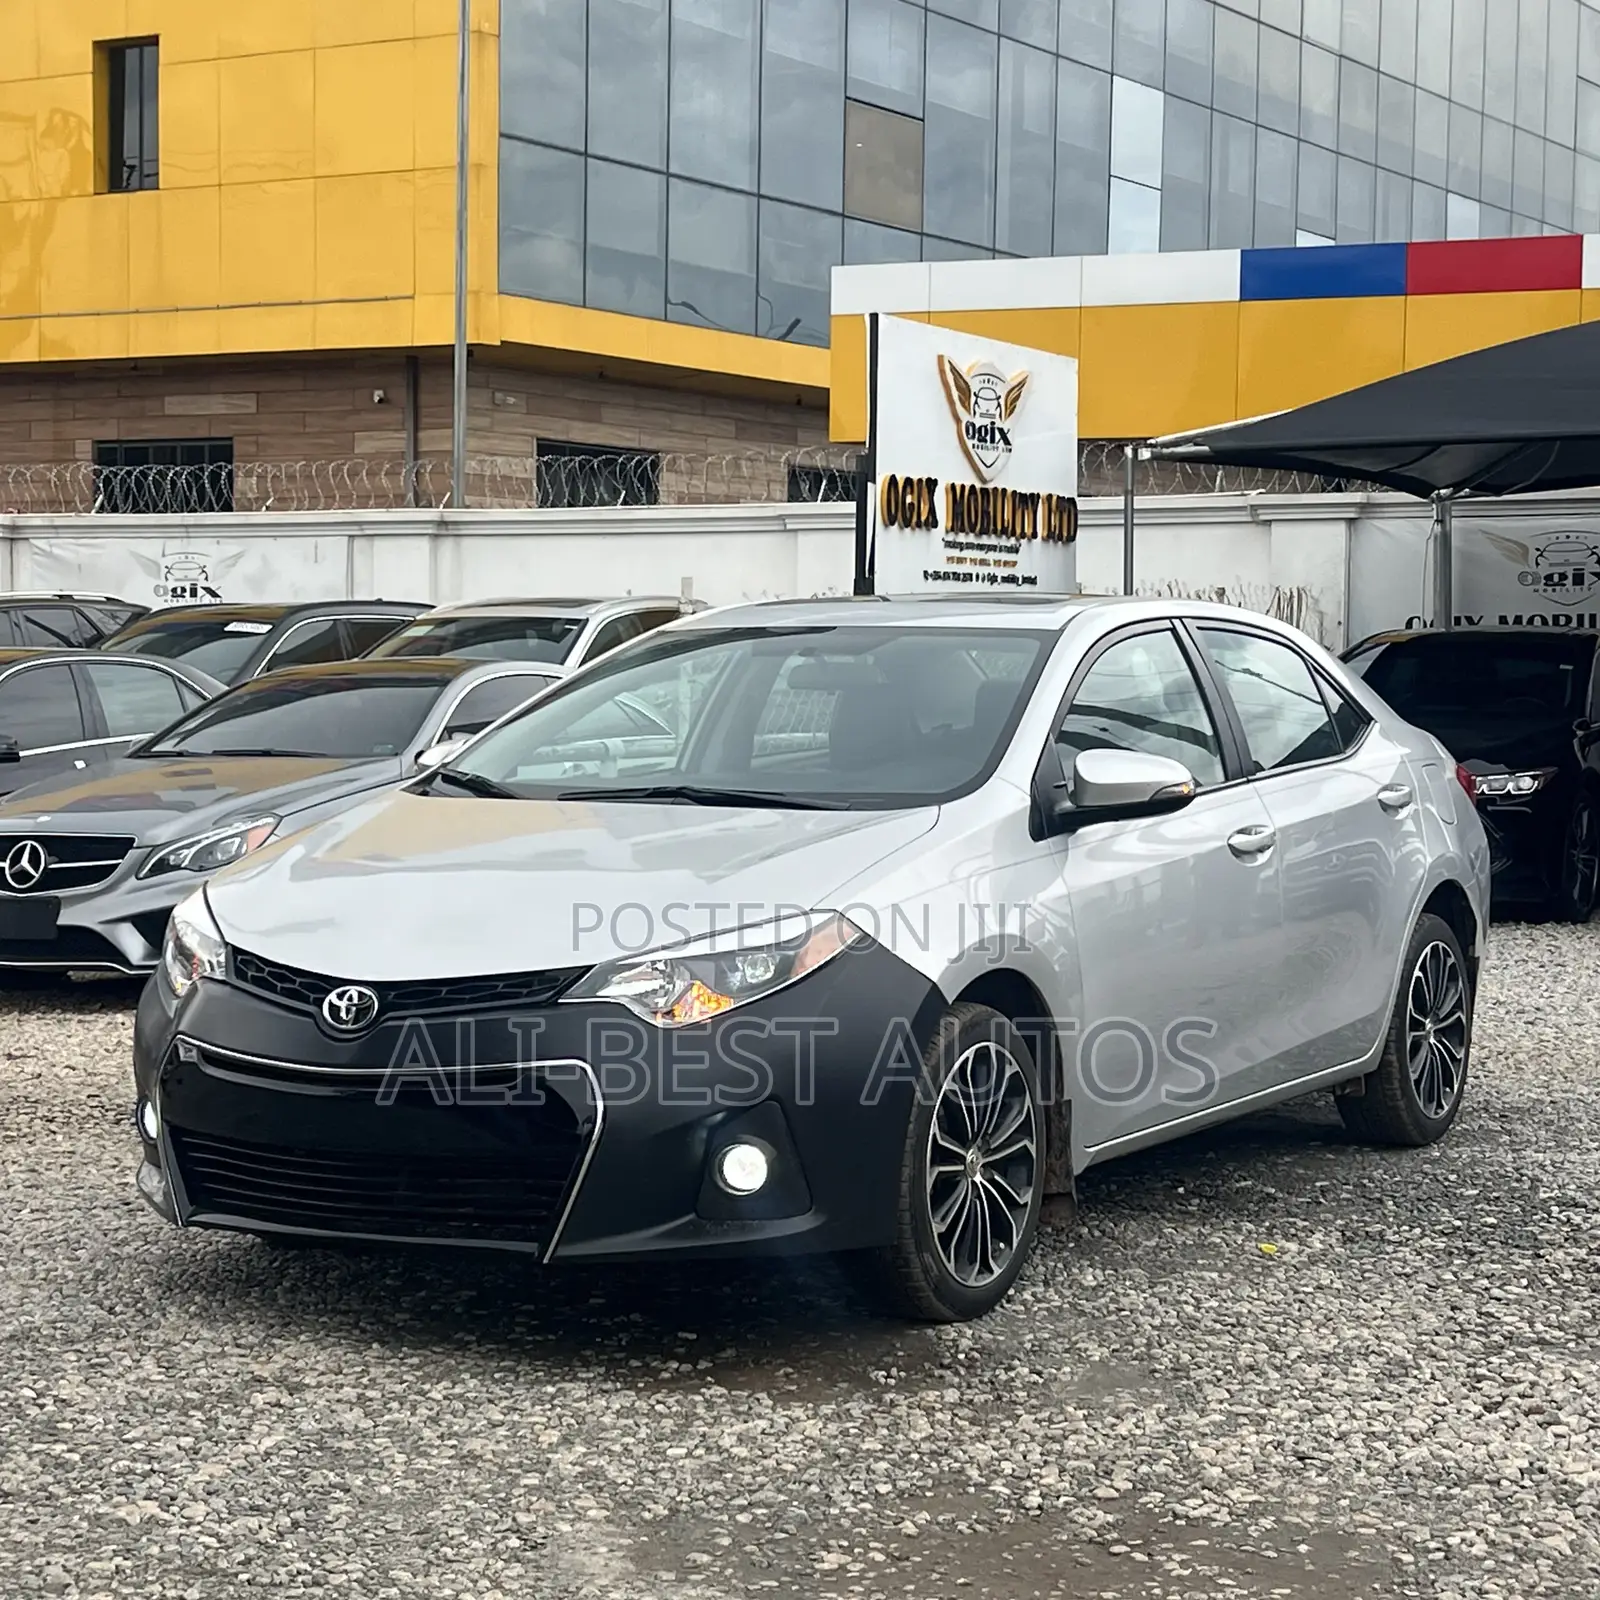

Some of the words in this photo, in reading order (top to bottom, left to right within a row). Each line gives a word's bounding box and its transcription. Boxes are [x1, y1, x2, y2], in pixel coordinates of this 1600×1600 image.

[881, 474, 938, 529] OGIX
[945, 482, 1040, 540] MOBILITY
[1042, 493, 1078, 542] LTD
